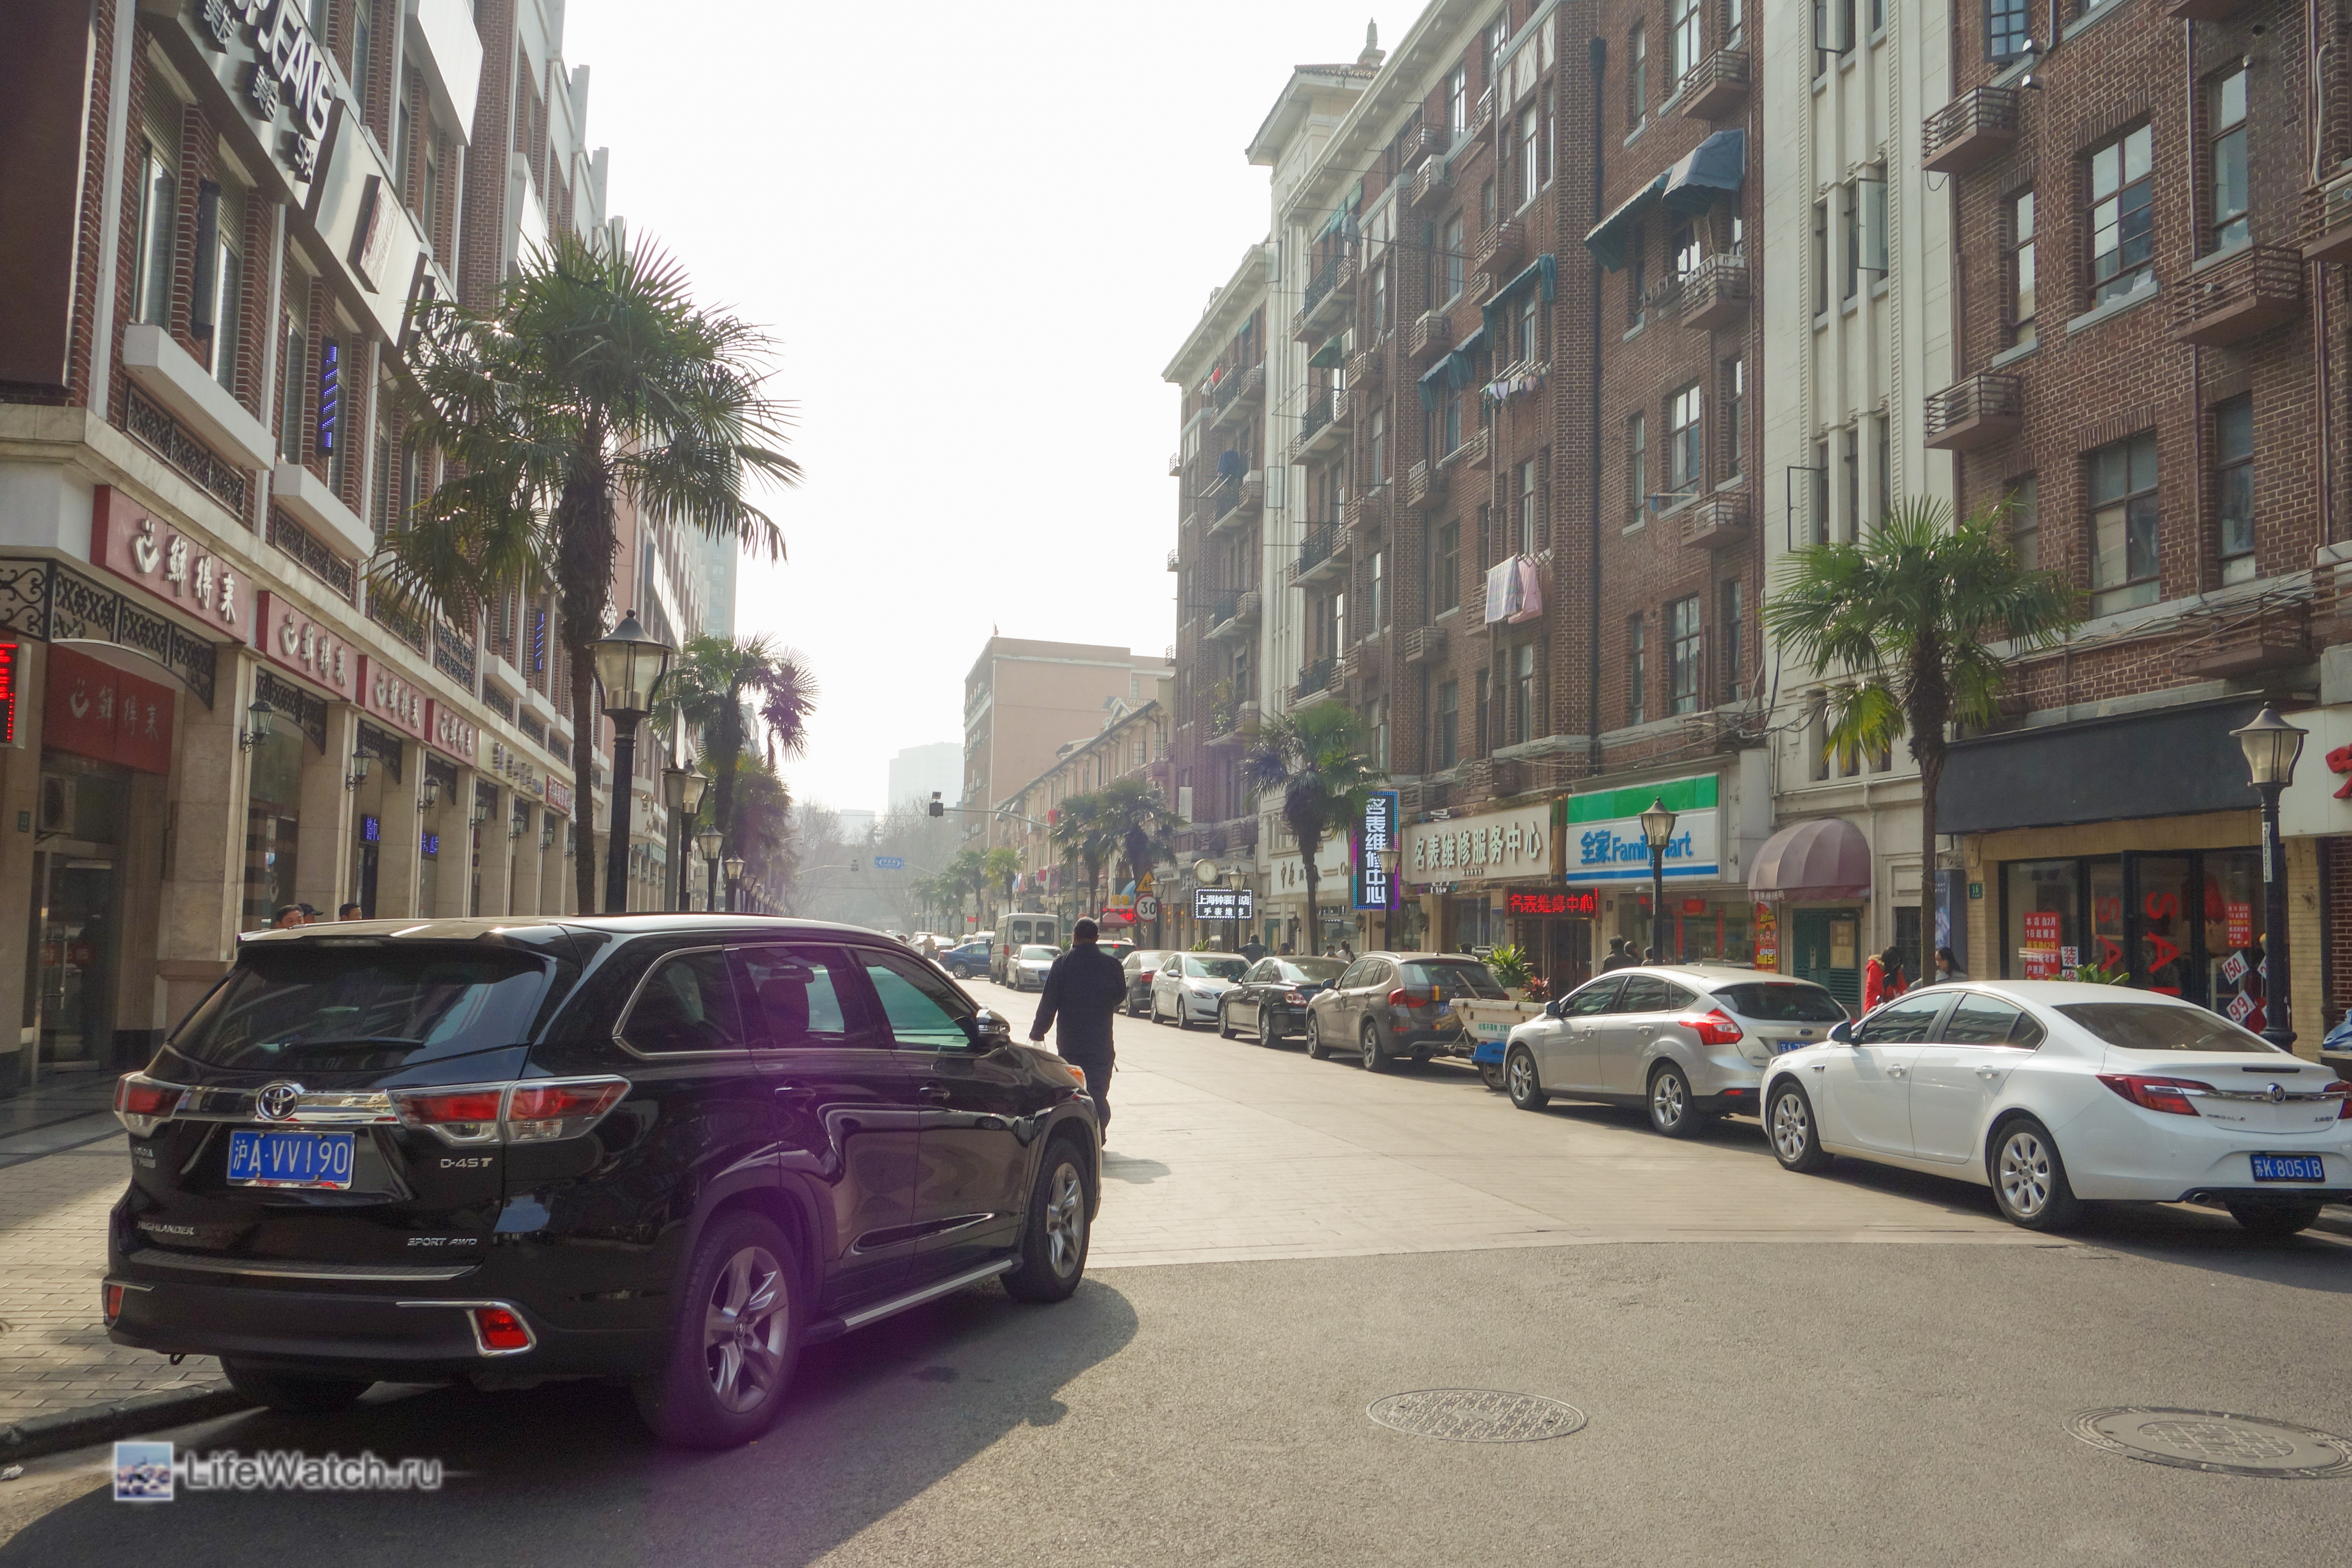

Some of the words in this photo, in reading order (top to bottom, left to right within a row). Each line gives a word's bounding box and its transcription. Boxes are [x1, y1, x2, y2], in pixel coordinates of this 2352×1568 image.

[294, 134, 314, 184] SPA
[1414, 822, 1541, 870] 名表维修服务中心
[1581, 830, 1611, 864] 全家
[1141, 902, 1156, 914] 30
[2225, 958, 2242, 981] 150
[2230, 997, 2249, 1021] 99
[407, 1237, 447, 1246] SPORT
[448, 1238, 478, 1246] AWD
